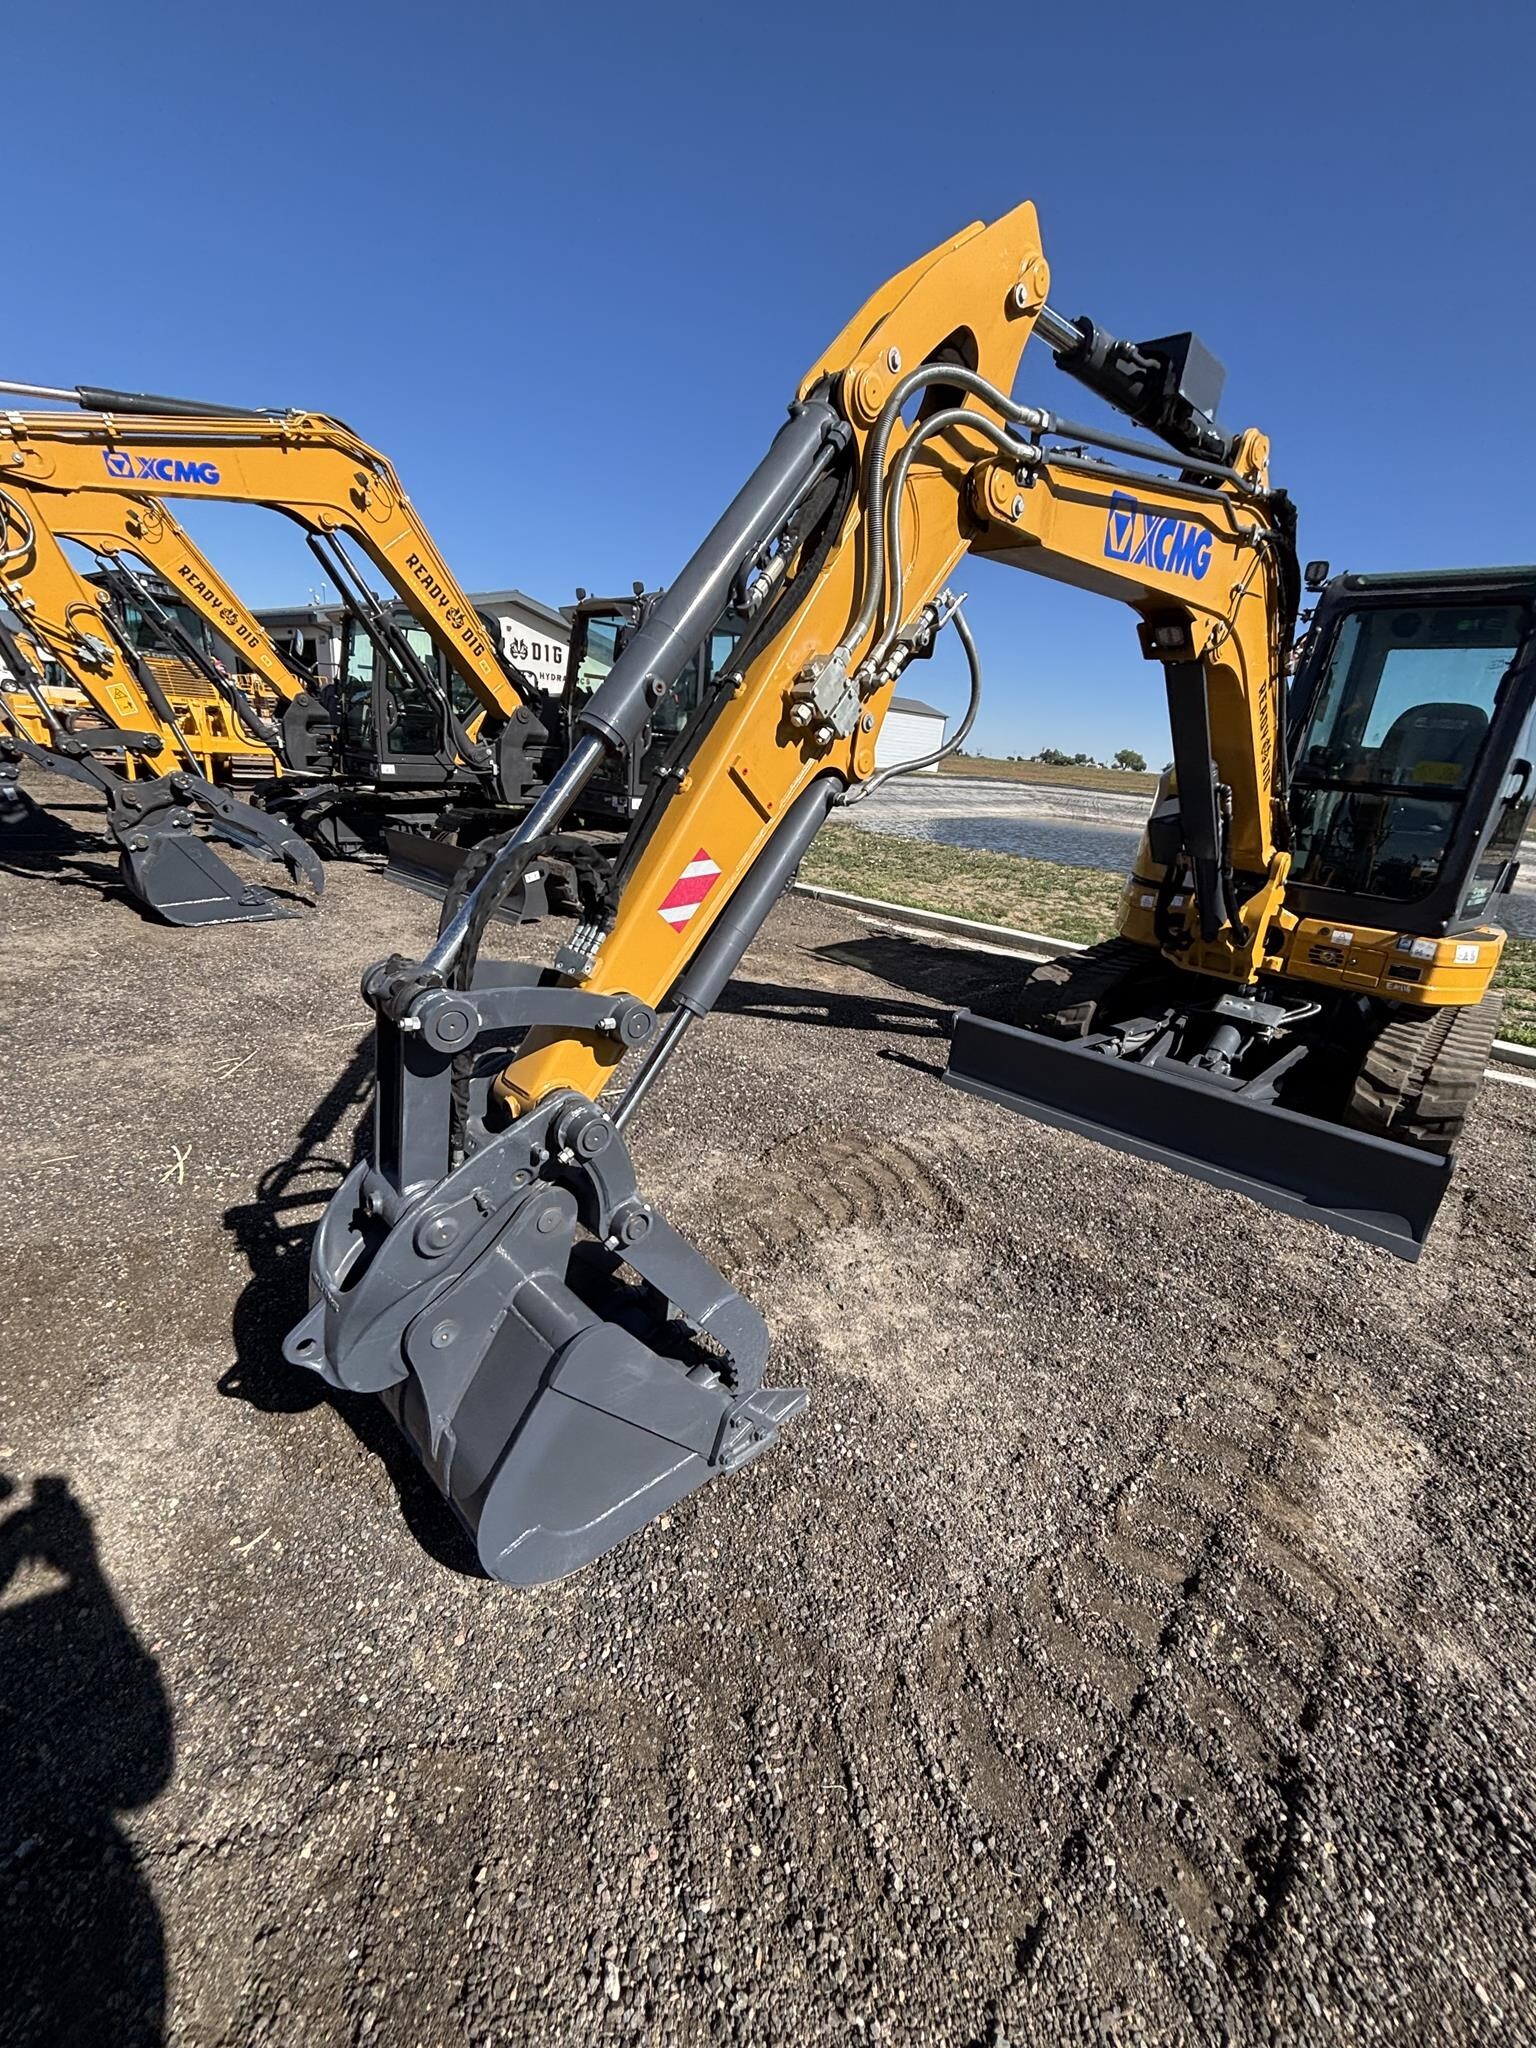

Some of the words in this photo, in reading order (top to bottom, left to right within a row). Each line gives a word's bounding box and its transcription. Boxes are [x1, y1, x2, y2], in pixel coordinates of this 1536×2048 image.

[134, 456, 220, 485] XCMG
[1130, 508, 1213, 580] XCMG
[178, 564, 222, 608] READY
[236, 624, 259, 648] DIG
[406, 553, 449, 608] READY
[461, 627, 485, 657] DIG
[531, 642, 562, 664] DIG
[1258, 679, 1268, 741] READY
[1262, 759, 1270, 792] DIG
